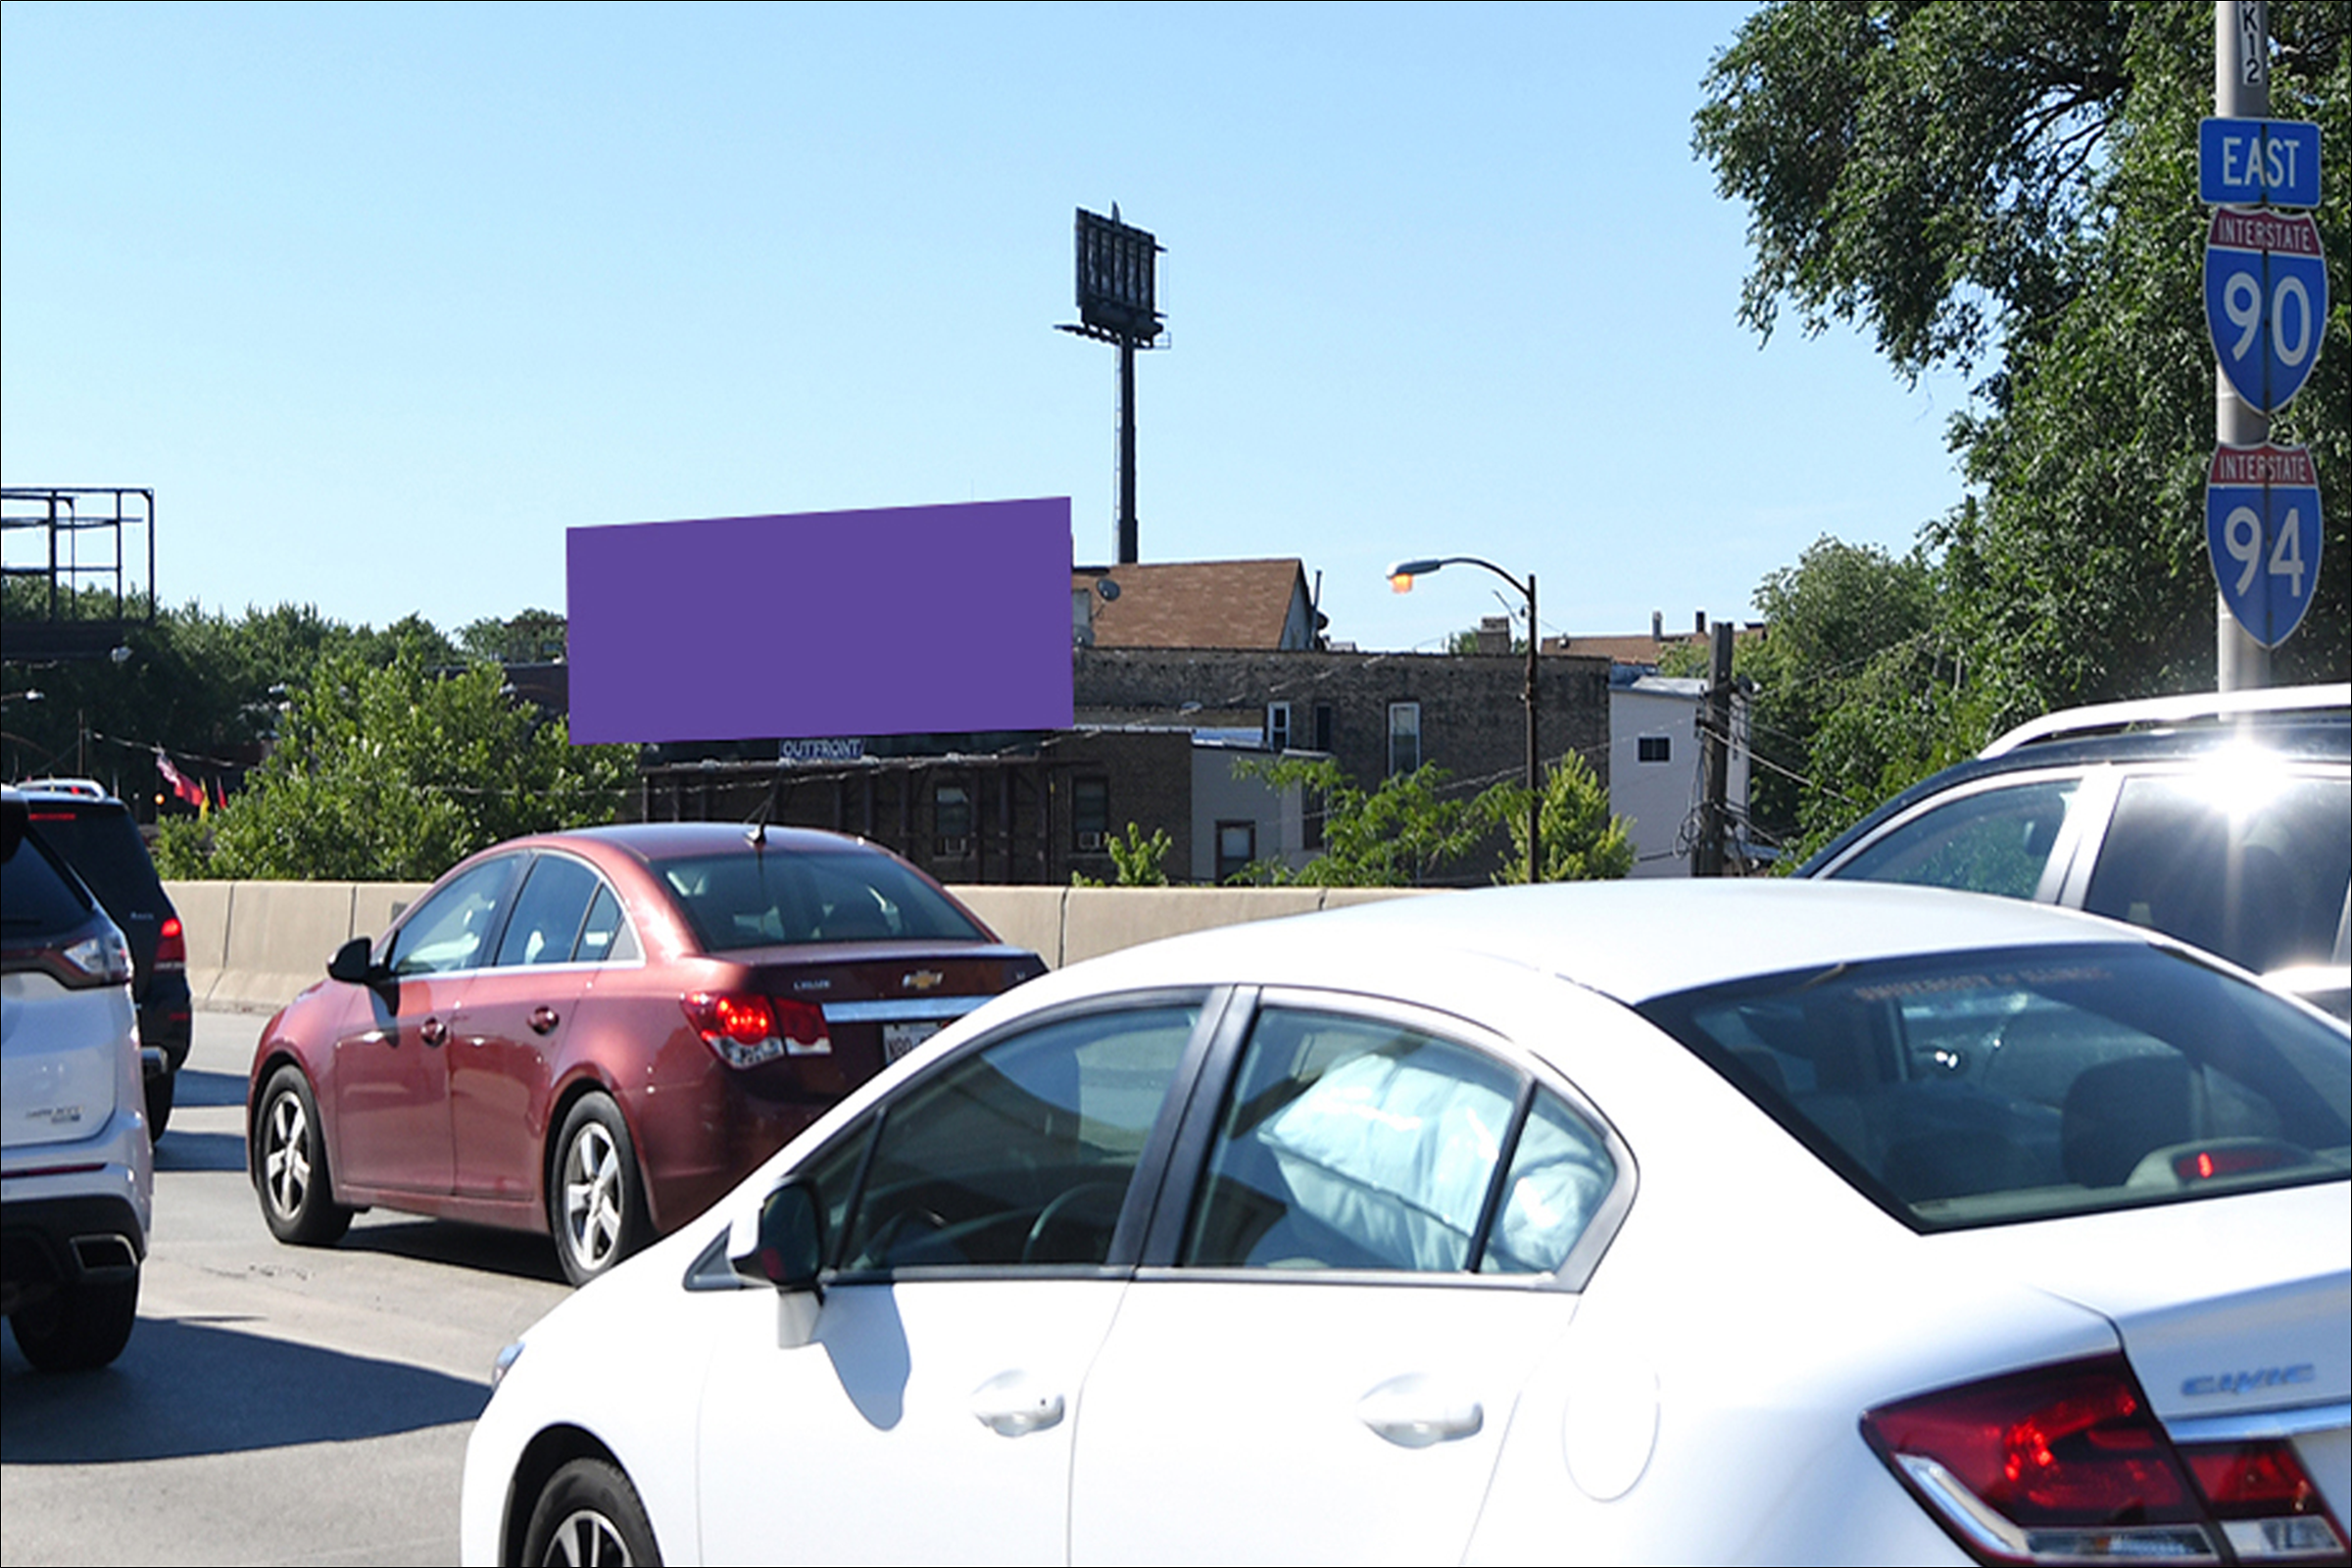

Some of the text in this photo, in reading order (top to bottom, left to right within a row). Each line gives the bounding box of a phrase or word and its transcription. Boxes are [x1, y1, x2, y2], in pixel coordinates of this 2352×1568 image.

[2242, 1, 2259, 82] K12
[2223, 136, 2300, 188] EAST
[2219, 218, 2311, 252] INTERSTATE
[2224, 270, 2311, 368] 90
[2220, 455, 2307, 481] INTERSTATE
[2224, 506, 2305, 598] 94
[2180, 1363, 2315, 1396] CIVIC
